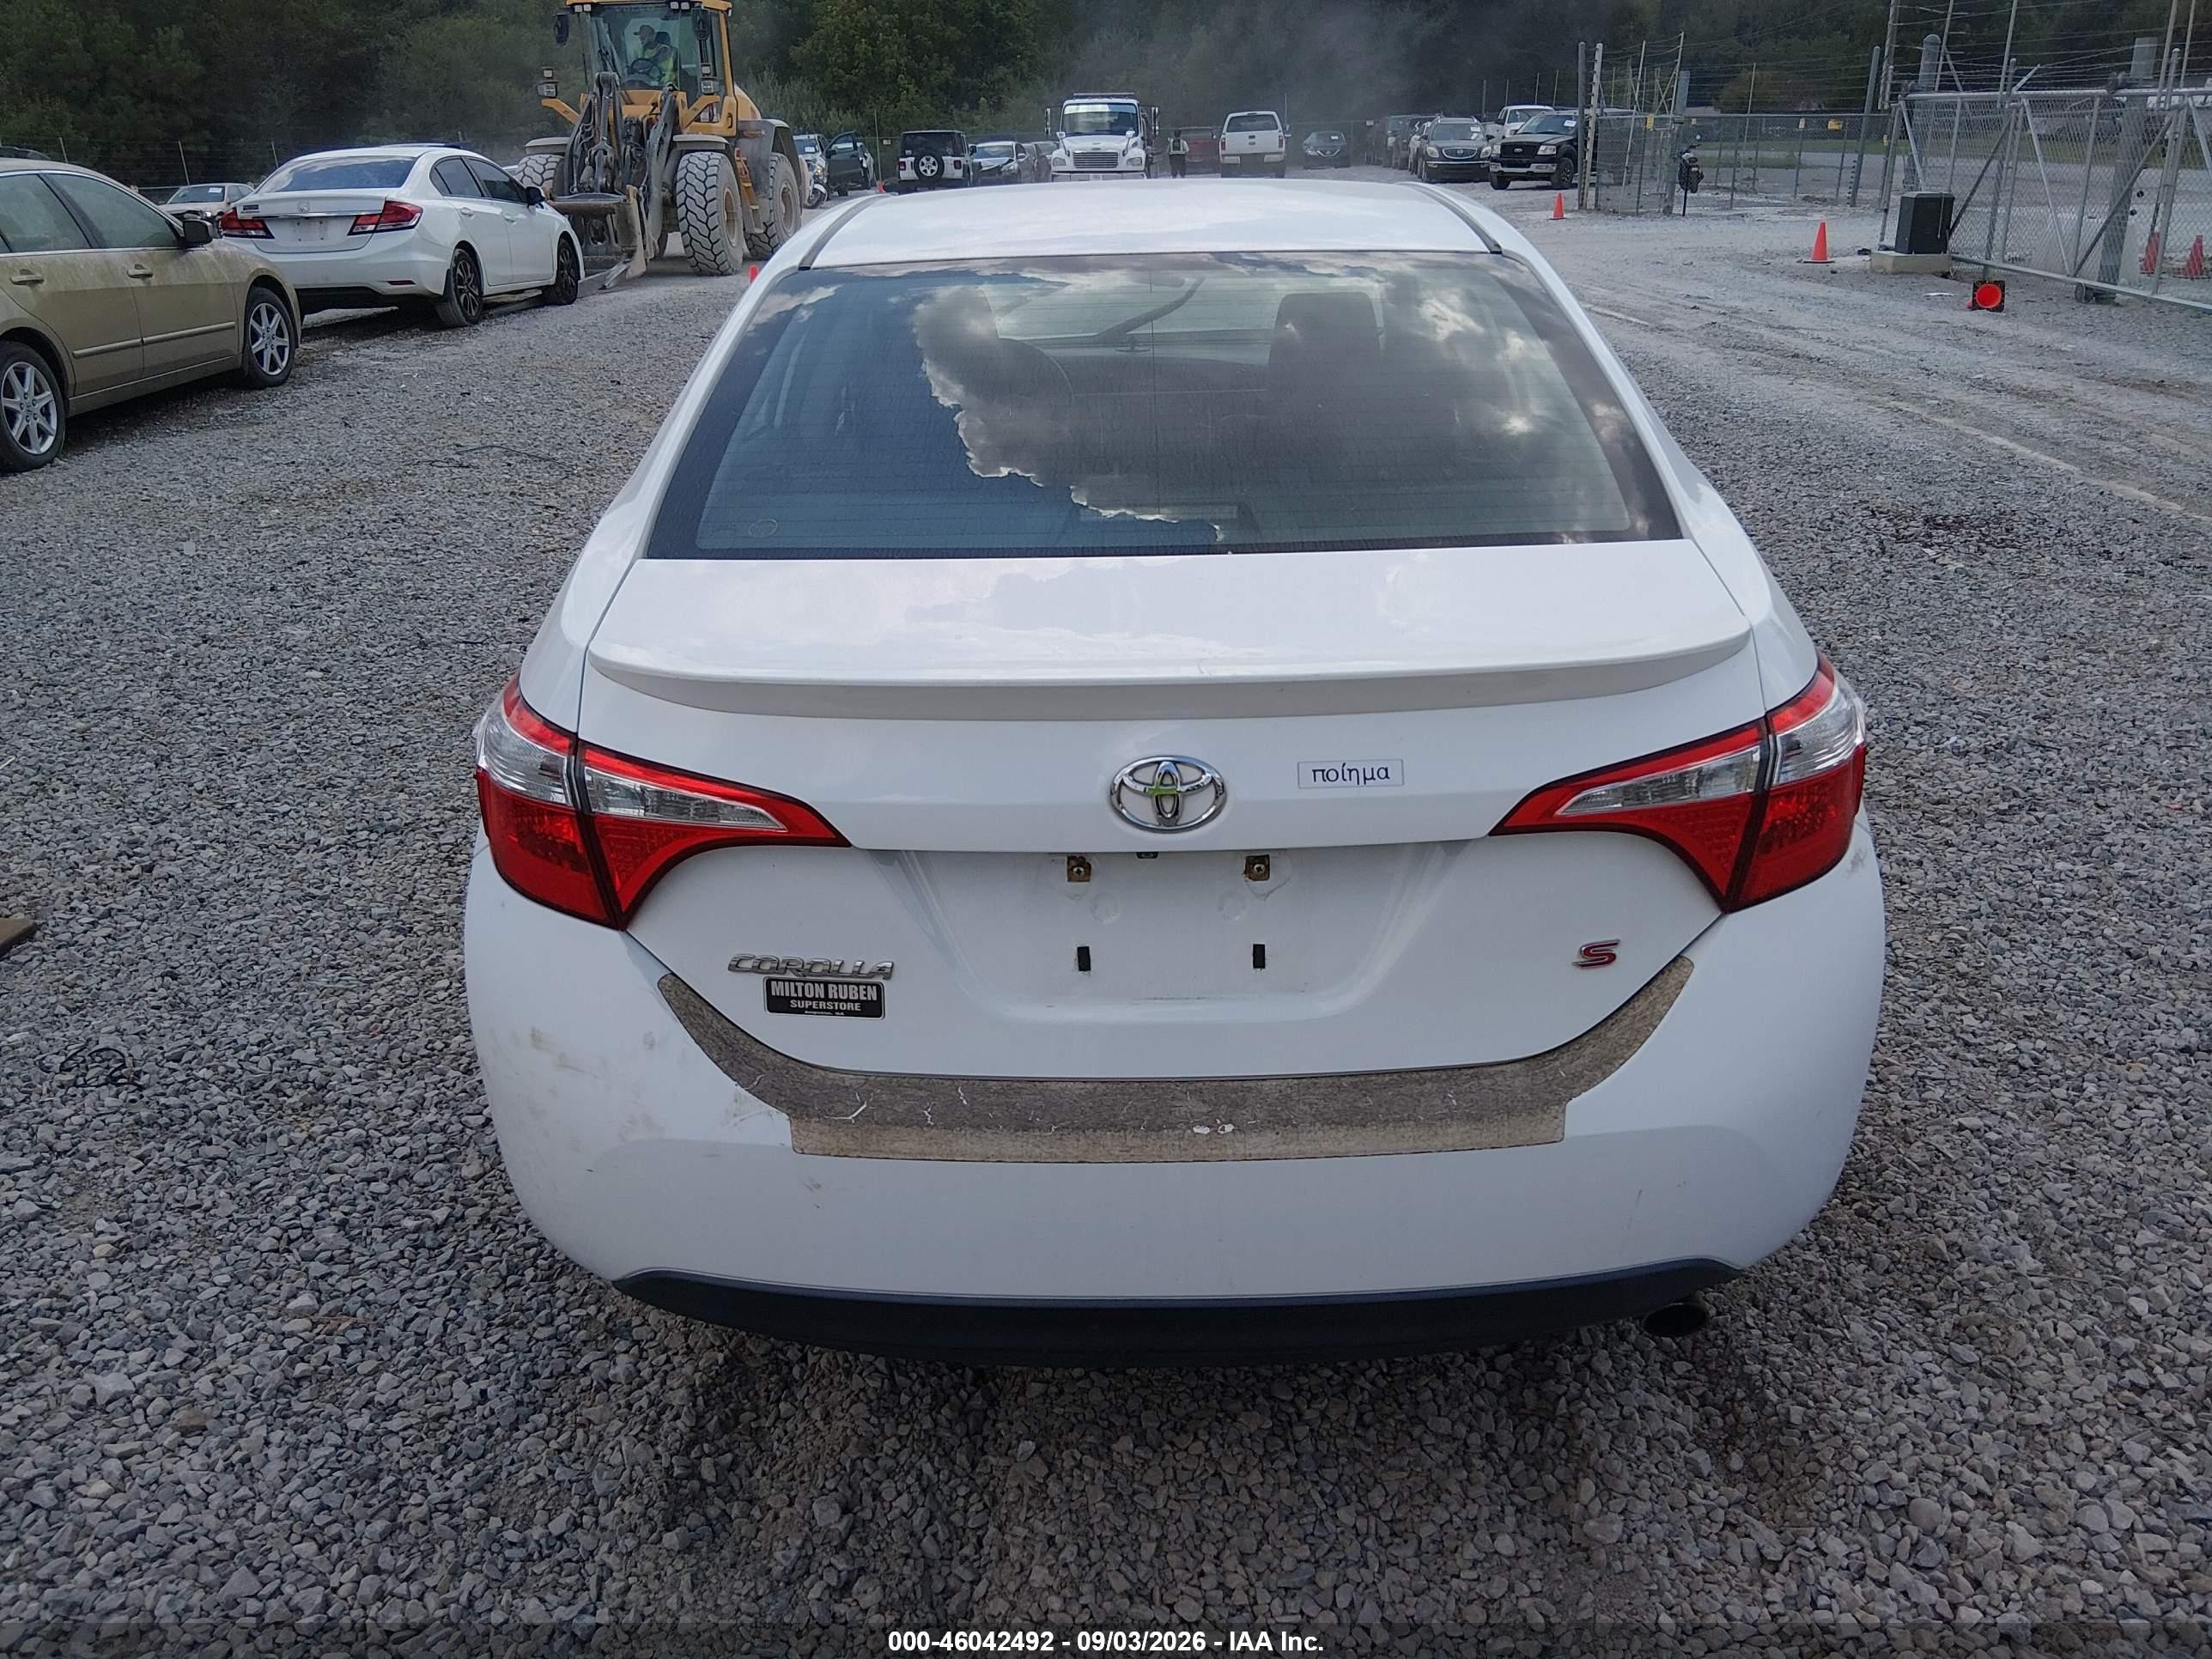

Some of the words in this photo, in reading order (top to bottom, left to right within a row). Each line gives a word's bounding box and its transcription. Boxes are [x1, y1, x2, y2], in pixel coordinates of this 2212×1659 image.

[1311, 762, 1390, 786] ποίημα
[1572, 939, 1620, 969] S
[728, 953, 895, 980] COROLLA
[770, 981, 824, 999] MILTON
[828, 983, 878, 1001] RUBEN
[790, 999, 861, 1011] SUPERSTORE
